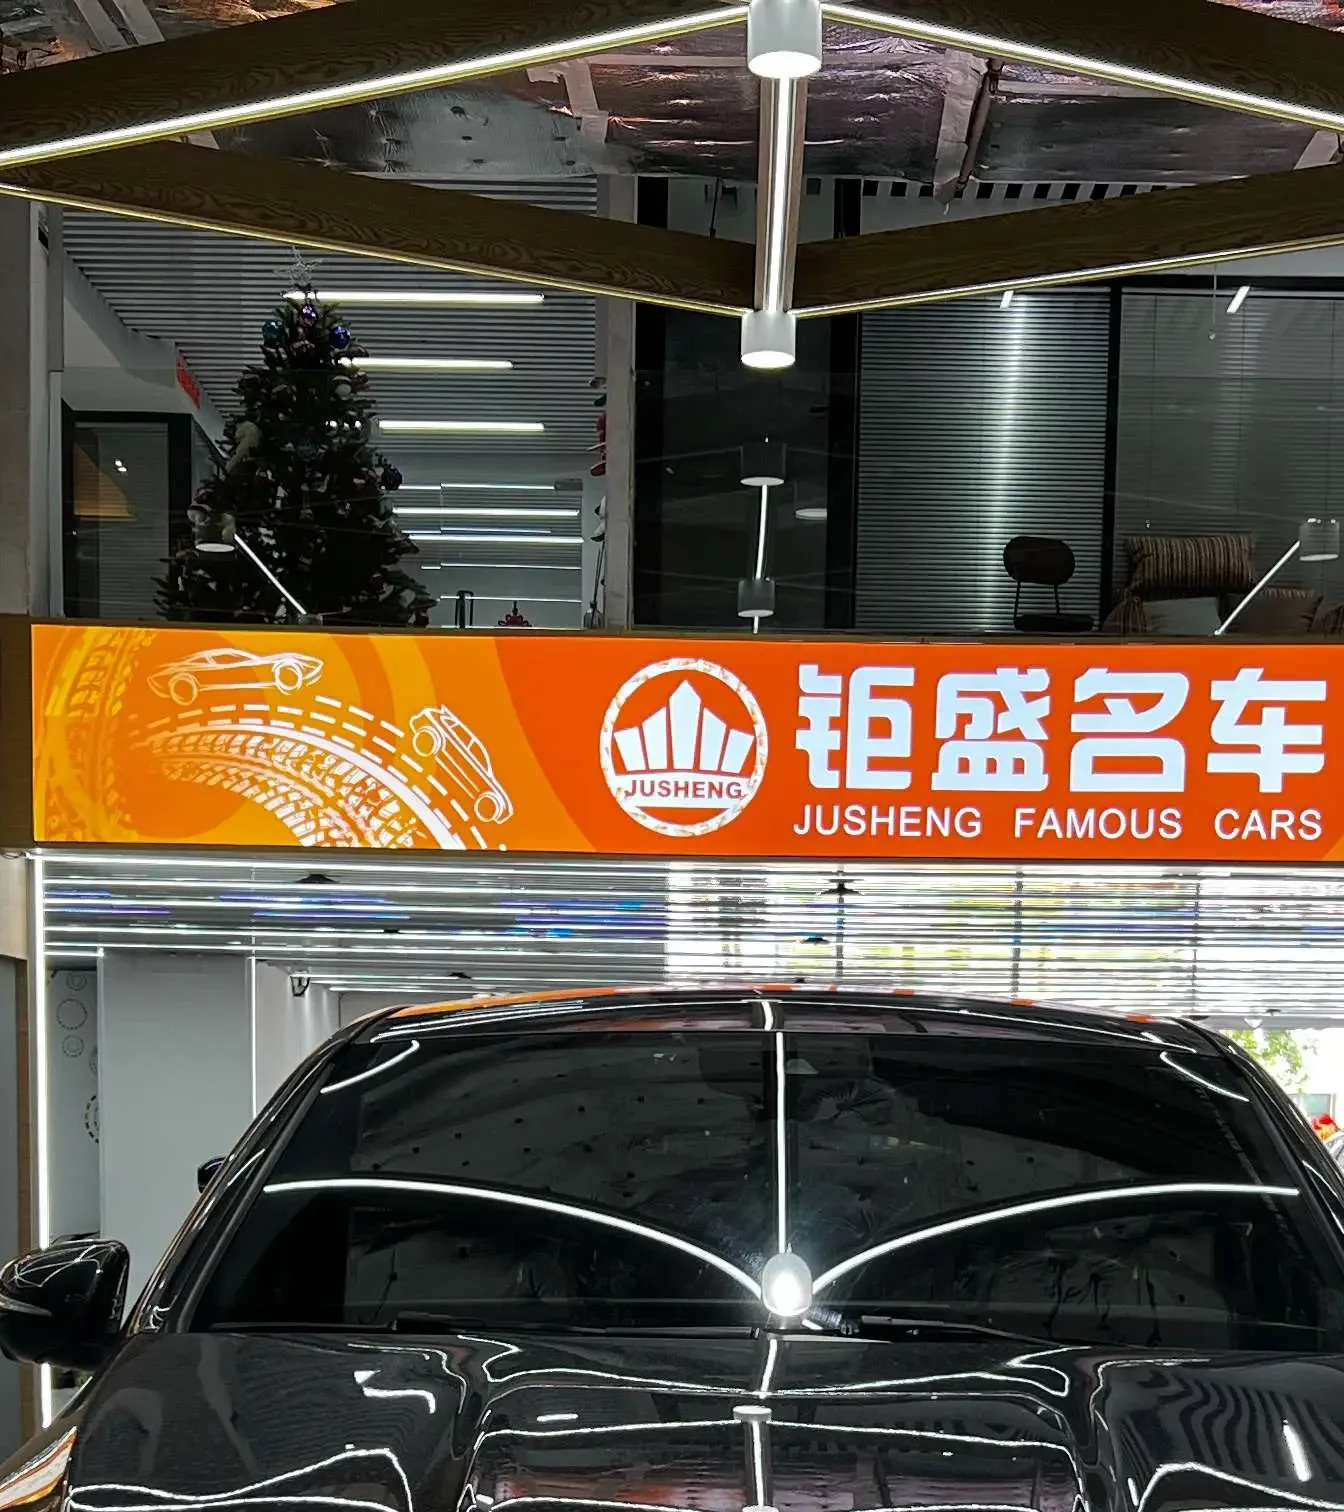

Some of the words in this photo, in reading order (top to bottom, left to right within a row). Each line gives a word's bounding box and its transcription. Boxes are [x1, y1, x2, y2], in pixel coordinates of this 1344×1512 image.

[795, 663, 1328, 793] 钜盛名车
[624, 779, 743, 799] JUSHENG
[794, 804, 982, 838] JUSHENG
[1014, 807, 1182, 839] FAMOUS
[1214, 808, 1322, 841] CARS
